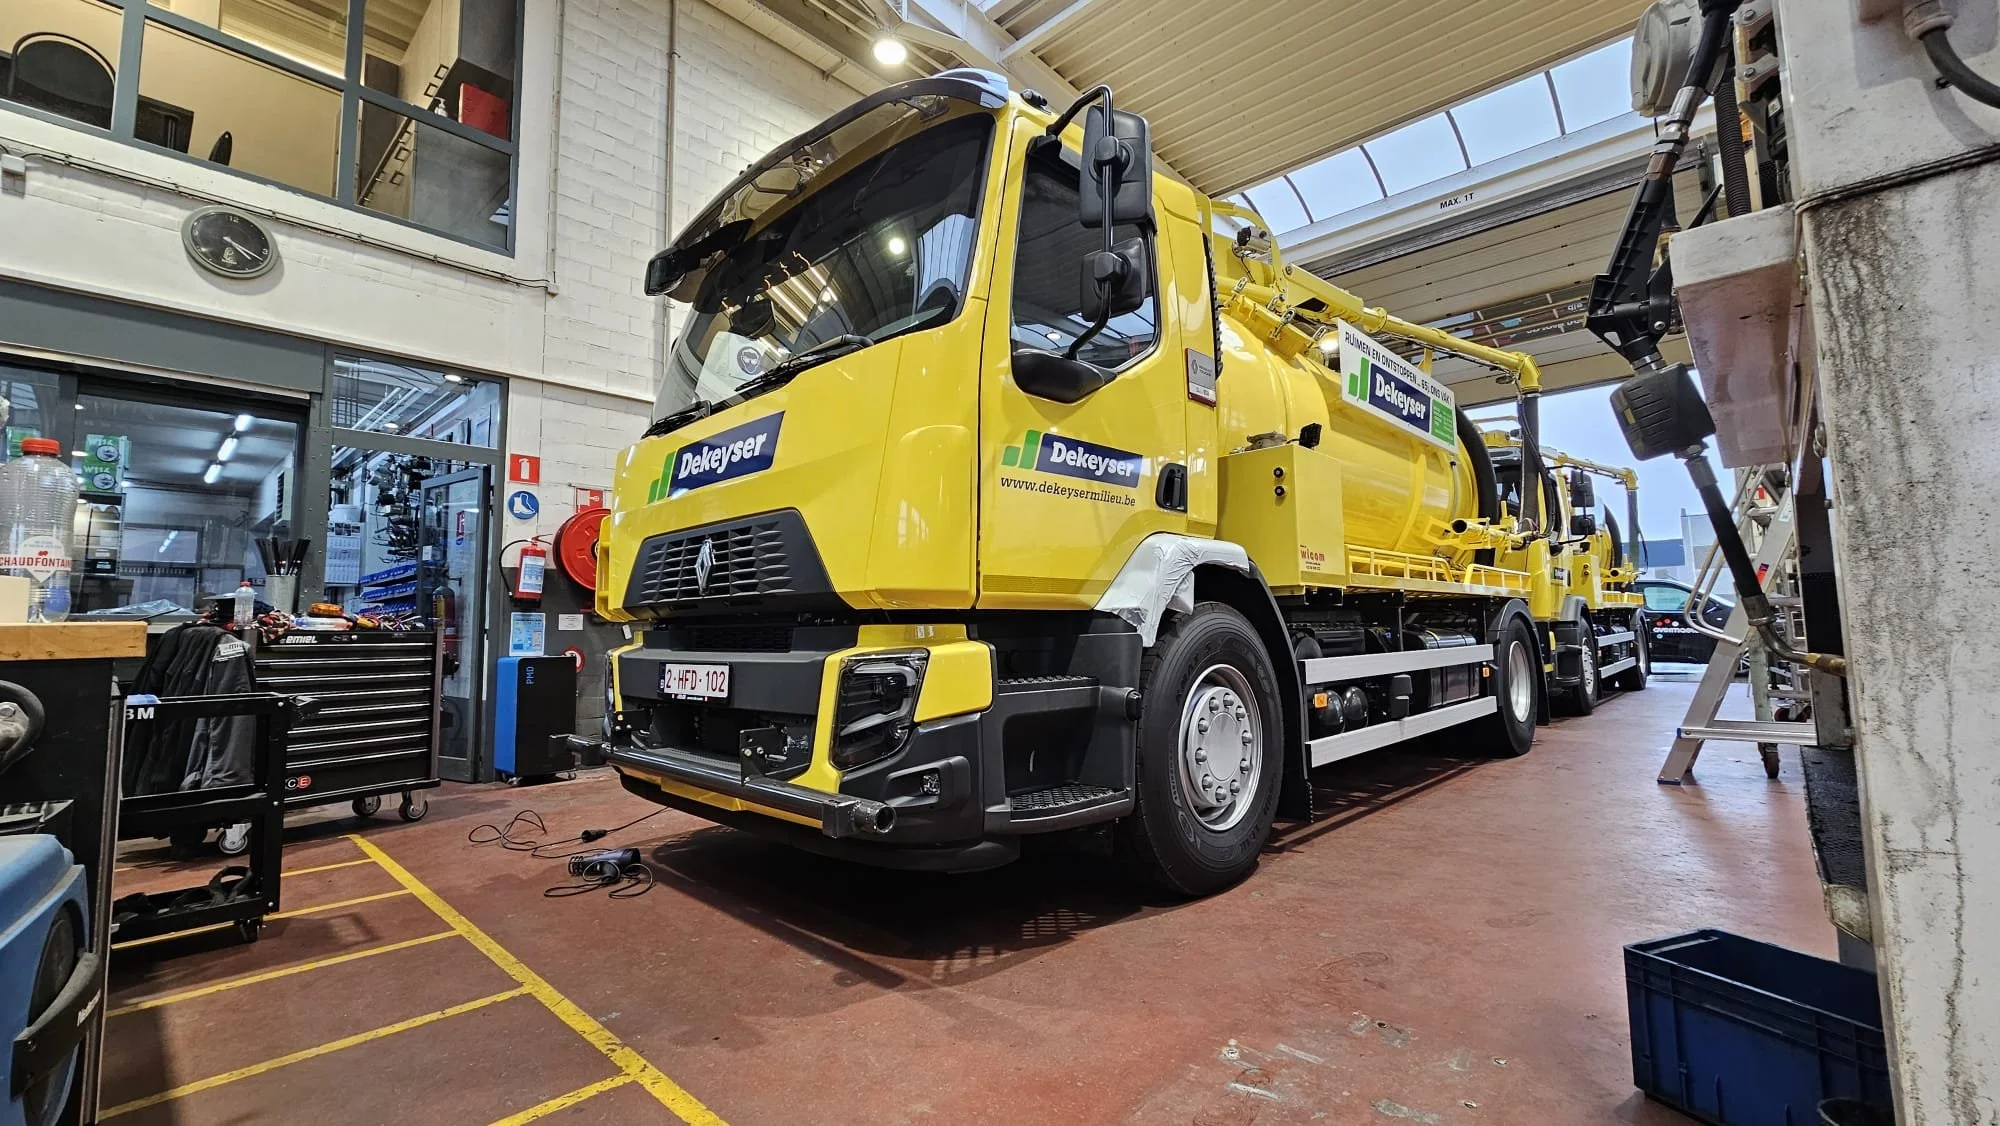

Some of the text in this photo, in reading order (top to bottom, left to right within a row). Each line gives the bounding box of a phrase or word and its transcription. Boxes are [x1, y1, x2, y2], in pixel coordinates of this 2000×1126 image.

[1440, 192, 1474, 209] MAX. 1T
[1345, 331, 1371, 356] RUIMEN
[1372, 348, 1381, 361] EN
[1375, 372, 1427, 420] Dekeyser
[678, 432, 768, 480] Dekeyser
[1050, 441, 1135, 477] Dekeyser
[1000, 476, 1136, 507] www.dekeysermilieu.be
[1300, 548, 1325, 561] wicom
